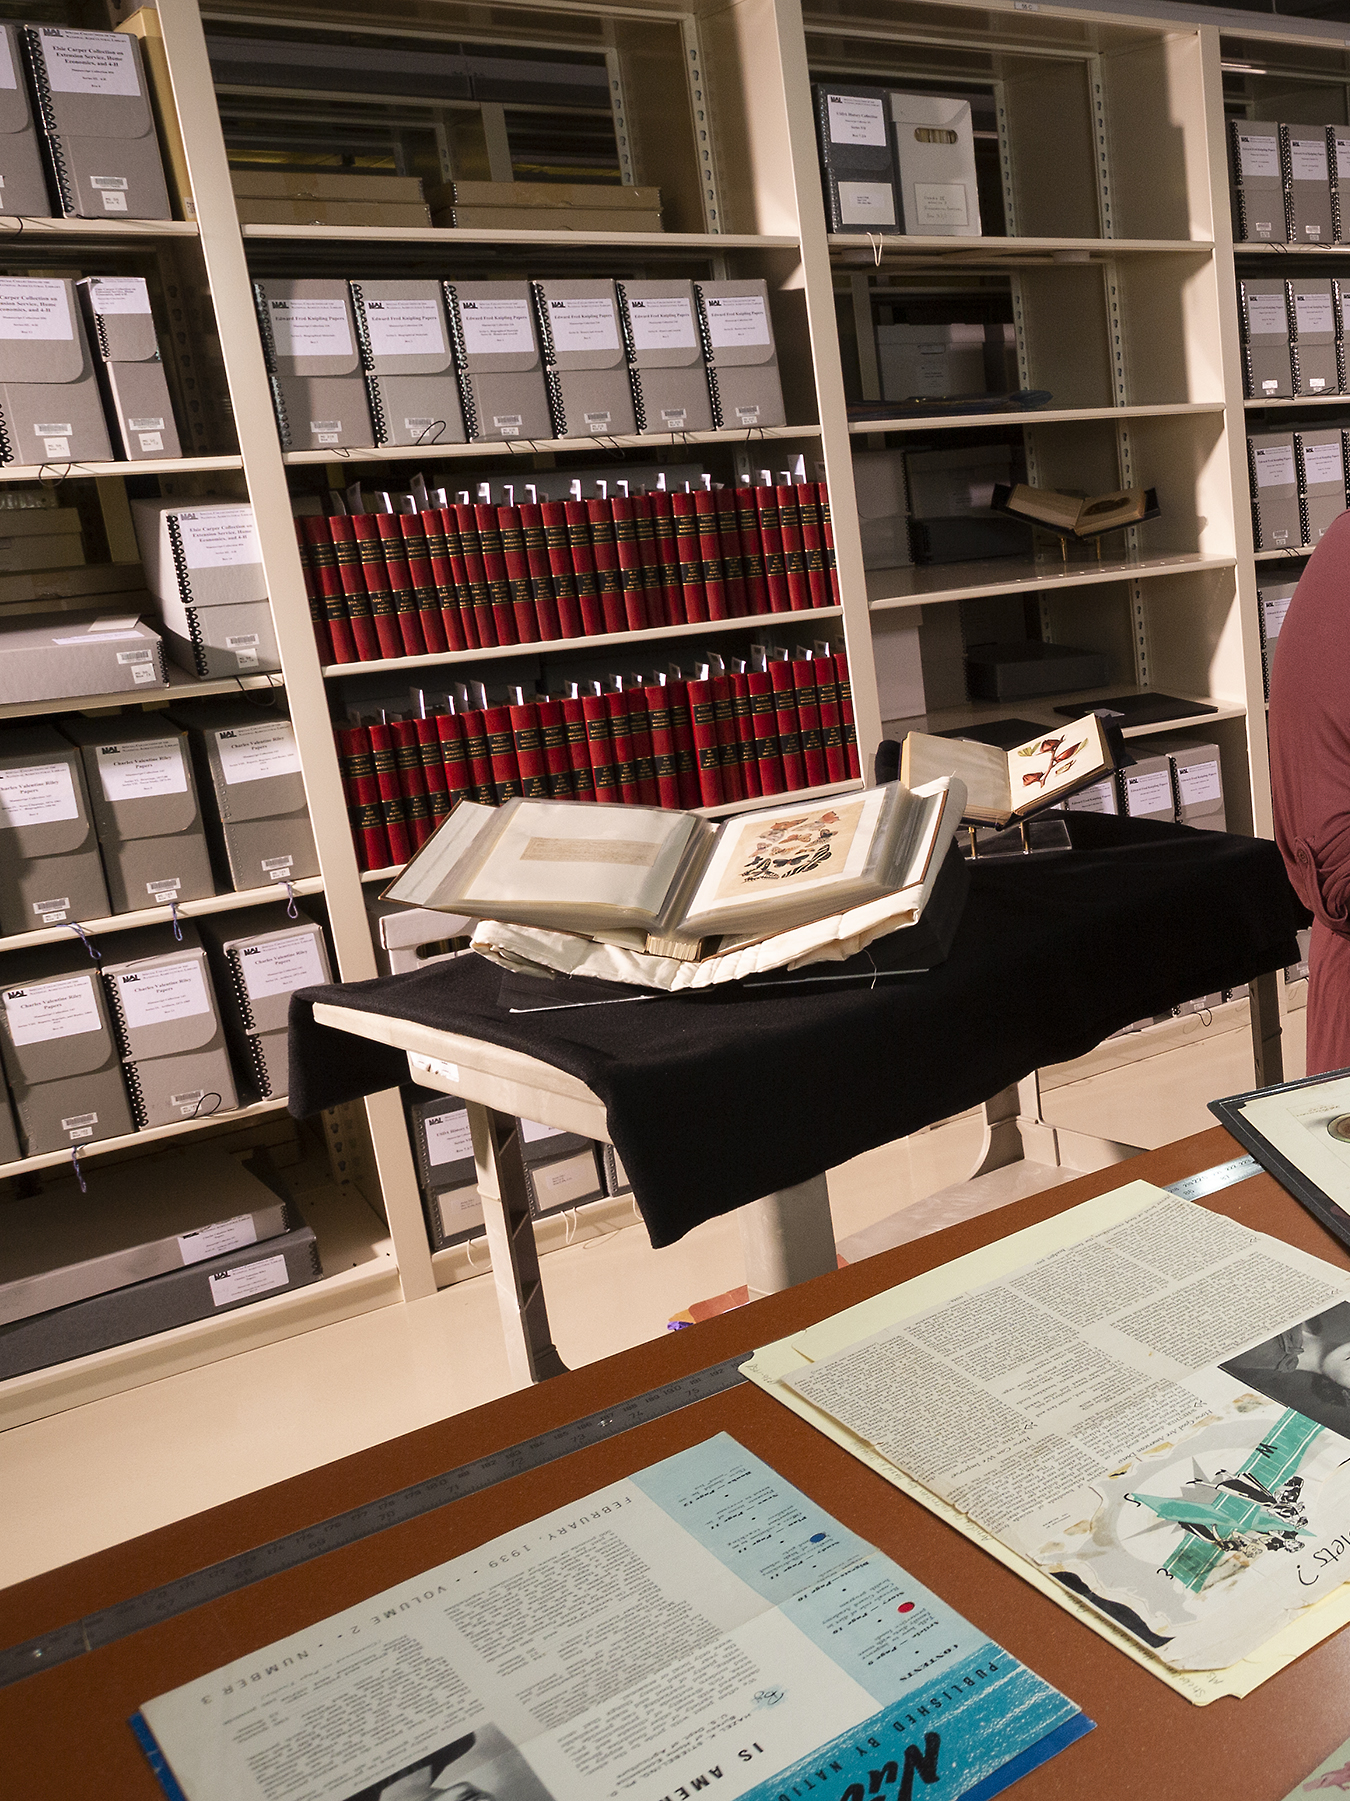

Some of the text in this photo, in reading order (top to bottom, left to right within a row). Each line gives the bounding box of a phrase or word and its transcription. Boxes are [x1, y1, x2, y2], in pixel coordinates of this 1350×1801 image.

[64, 58, 95, 66] Economics,
[20, 1001, 41, 1009] Charles
[42, 996, 67, 1004] Valentine
[1195, 1409, 1212, 1419] How
[1013, 1436, 1030, 1446] How
[1136, 1436, 1163, 1451] American
[488, 1545, 529, 1567] 1939
[371, 1586, 445, 1623] VOLUME
[883, 1592, 903, 1604] Story
[848, 1612, 866, 1624] Page
[350, 1625, 359, 1633] 2
[912, 1622, 938, 1637] Article
[876, 1646, 896, 1659] Page
[900, 1644, 957, 1680] CONTENTS
[223, 1651, 307, 1694] NUMBER
[201, 1695, 211, 1704] 3
[893, 1662, 997, 1730] PUBLISHED
[738, 1742, 764, 1762] IS
[855, 1737, 881, 1758] BY
